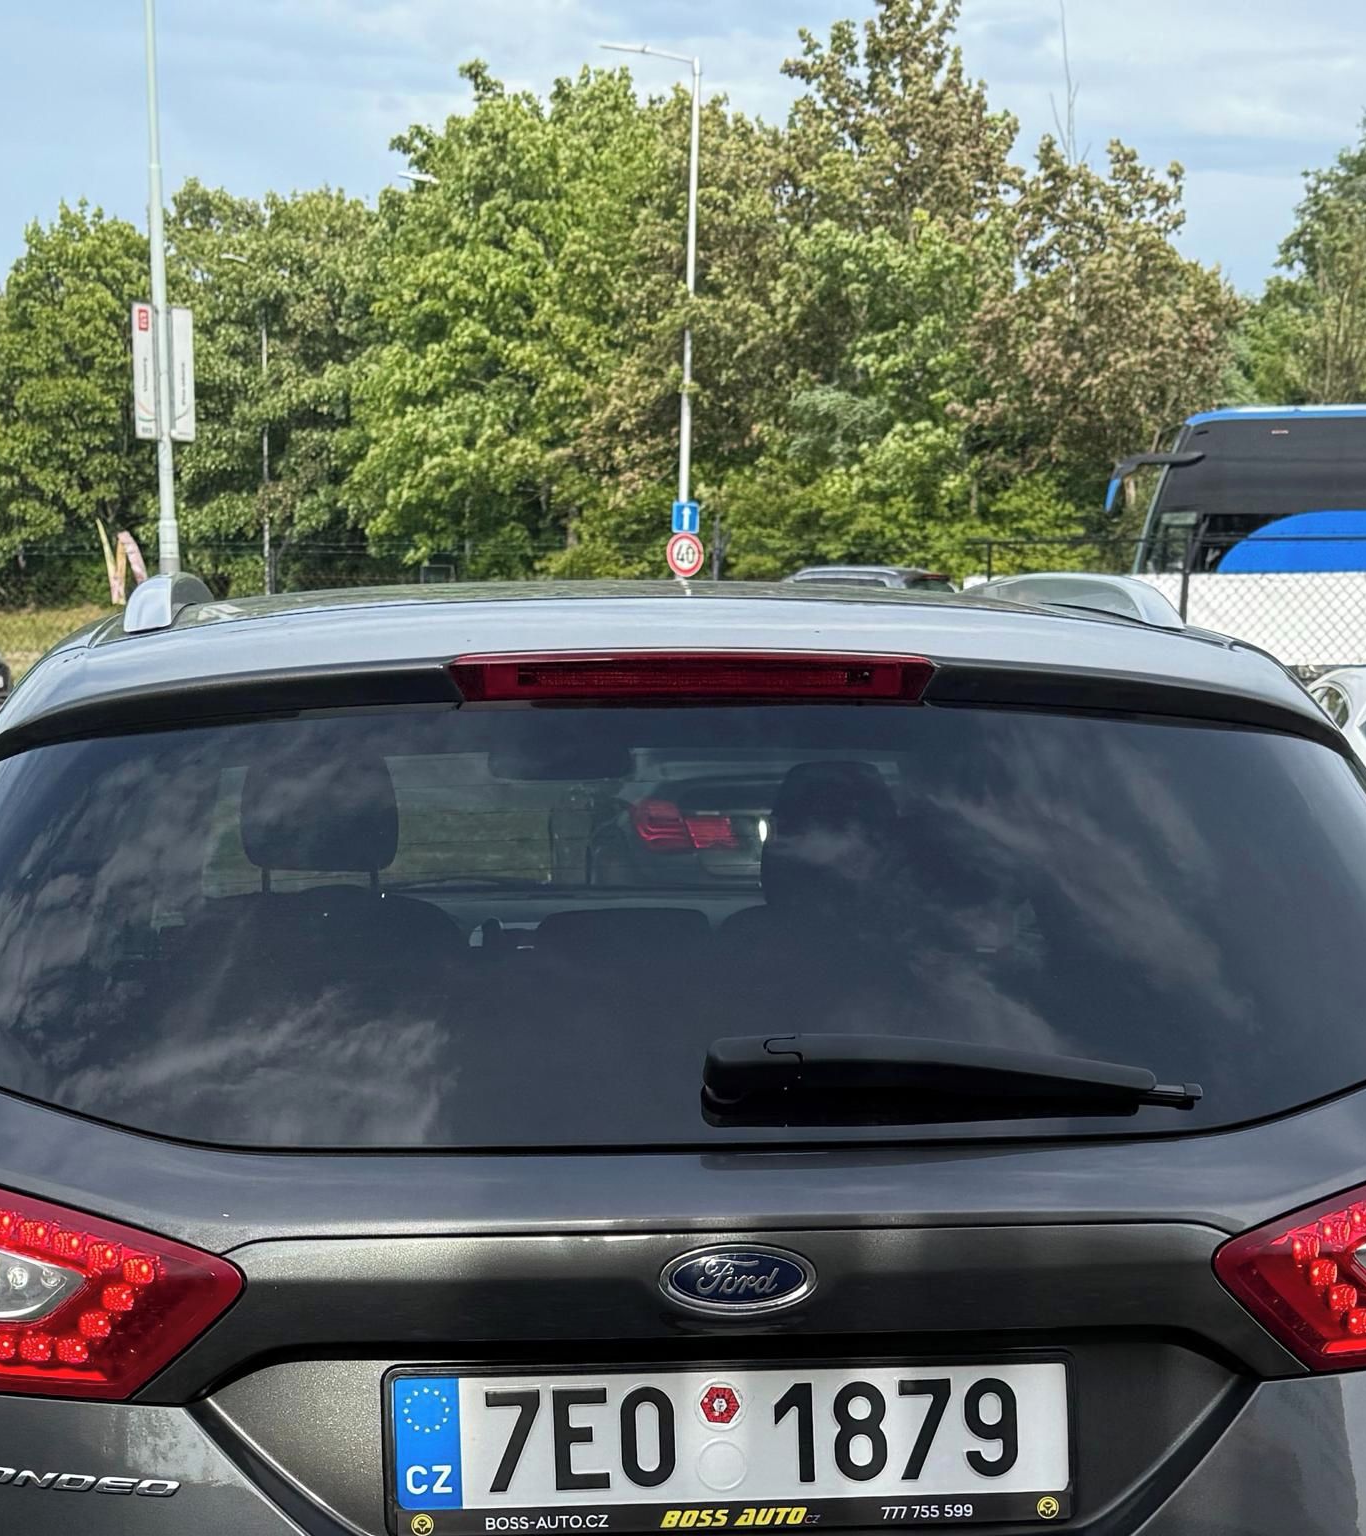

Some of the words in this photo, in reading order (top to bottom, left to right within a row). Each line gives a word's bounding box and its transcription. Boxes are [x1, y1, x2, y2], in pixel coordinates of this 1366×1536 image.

[676, 544, 696, 564] 40
[696, 1259, 780, 1295] Ford
[405, 1465, 453, 1495] CZ
[485, 1386, 677, 1493] 7E0
[774, 1377, 1019, 1483] 1879
[485, 1514, 609, 1531] BOSS-AUTO.CZ
[659, 1509, 729, 1529] BOSS
[733, 1506, 808, 1527] AUTO
[880, 1505, 908, 1520] 777
[911, 1505, 941, 1519] 755
[943, 1503, 974, 1518] 599
